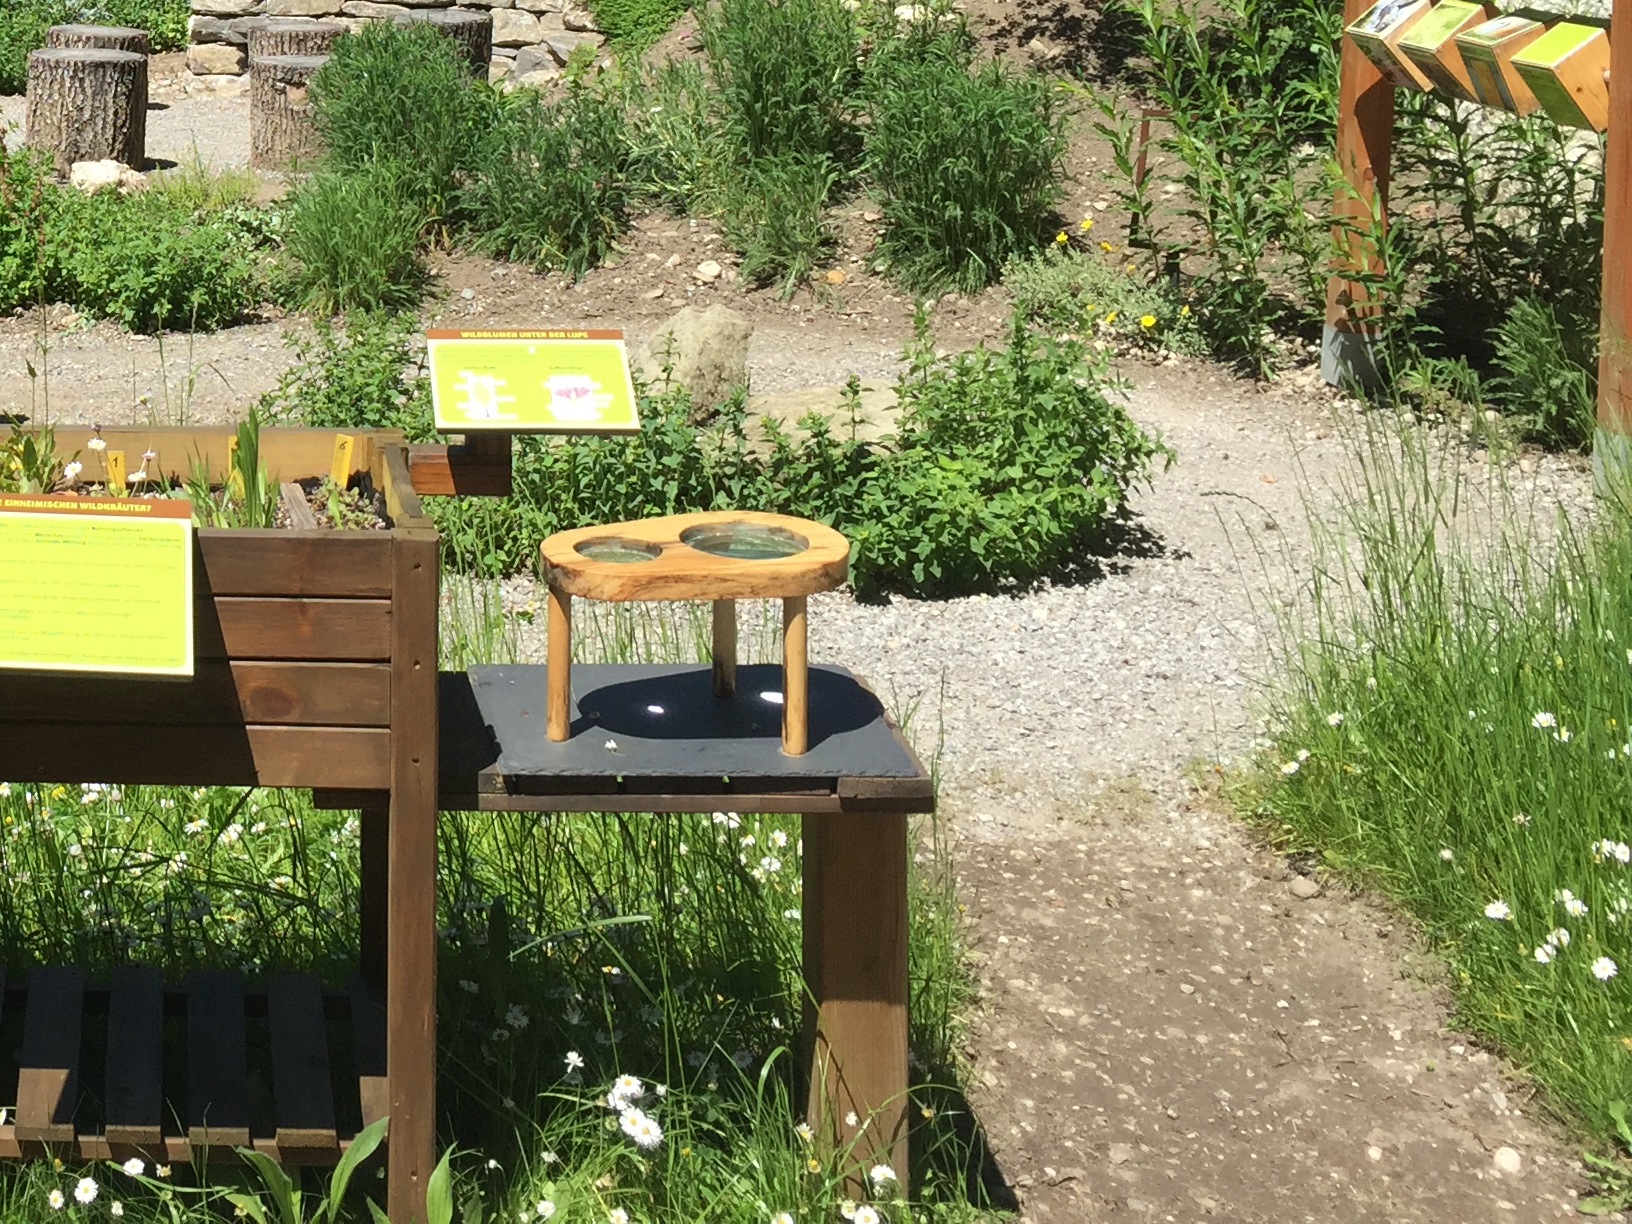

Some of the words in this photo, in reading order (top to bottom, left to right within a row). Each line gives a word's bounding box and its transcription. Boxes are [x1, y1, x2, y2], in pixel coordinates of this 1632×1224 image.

[460, 330, 518, 338] WILDBLUMEN
[519, 331, 547, 339] UNTER
[549, 331, 566, 339] DER
[4, 498, 78, 510] EINHEIMISCHEN
[79, 500, 152, 513] WILDKRÄUTER?
